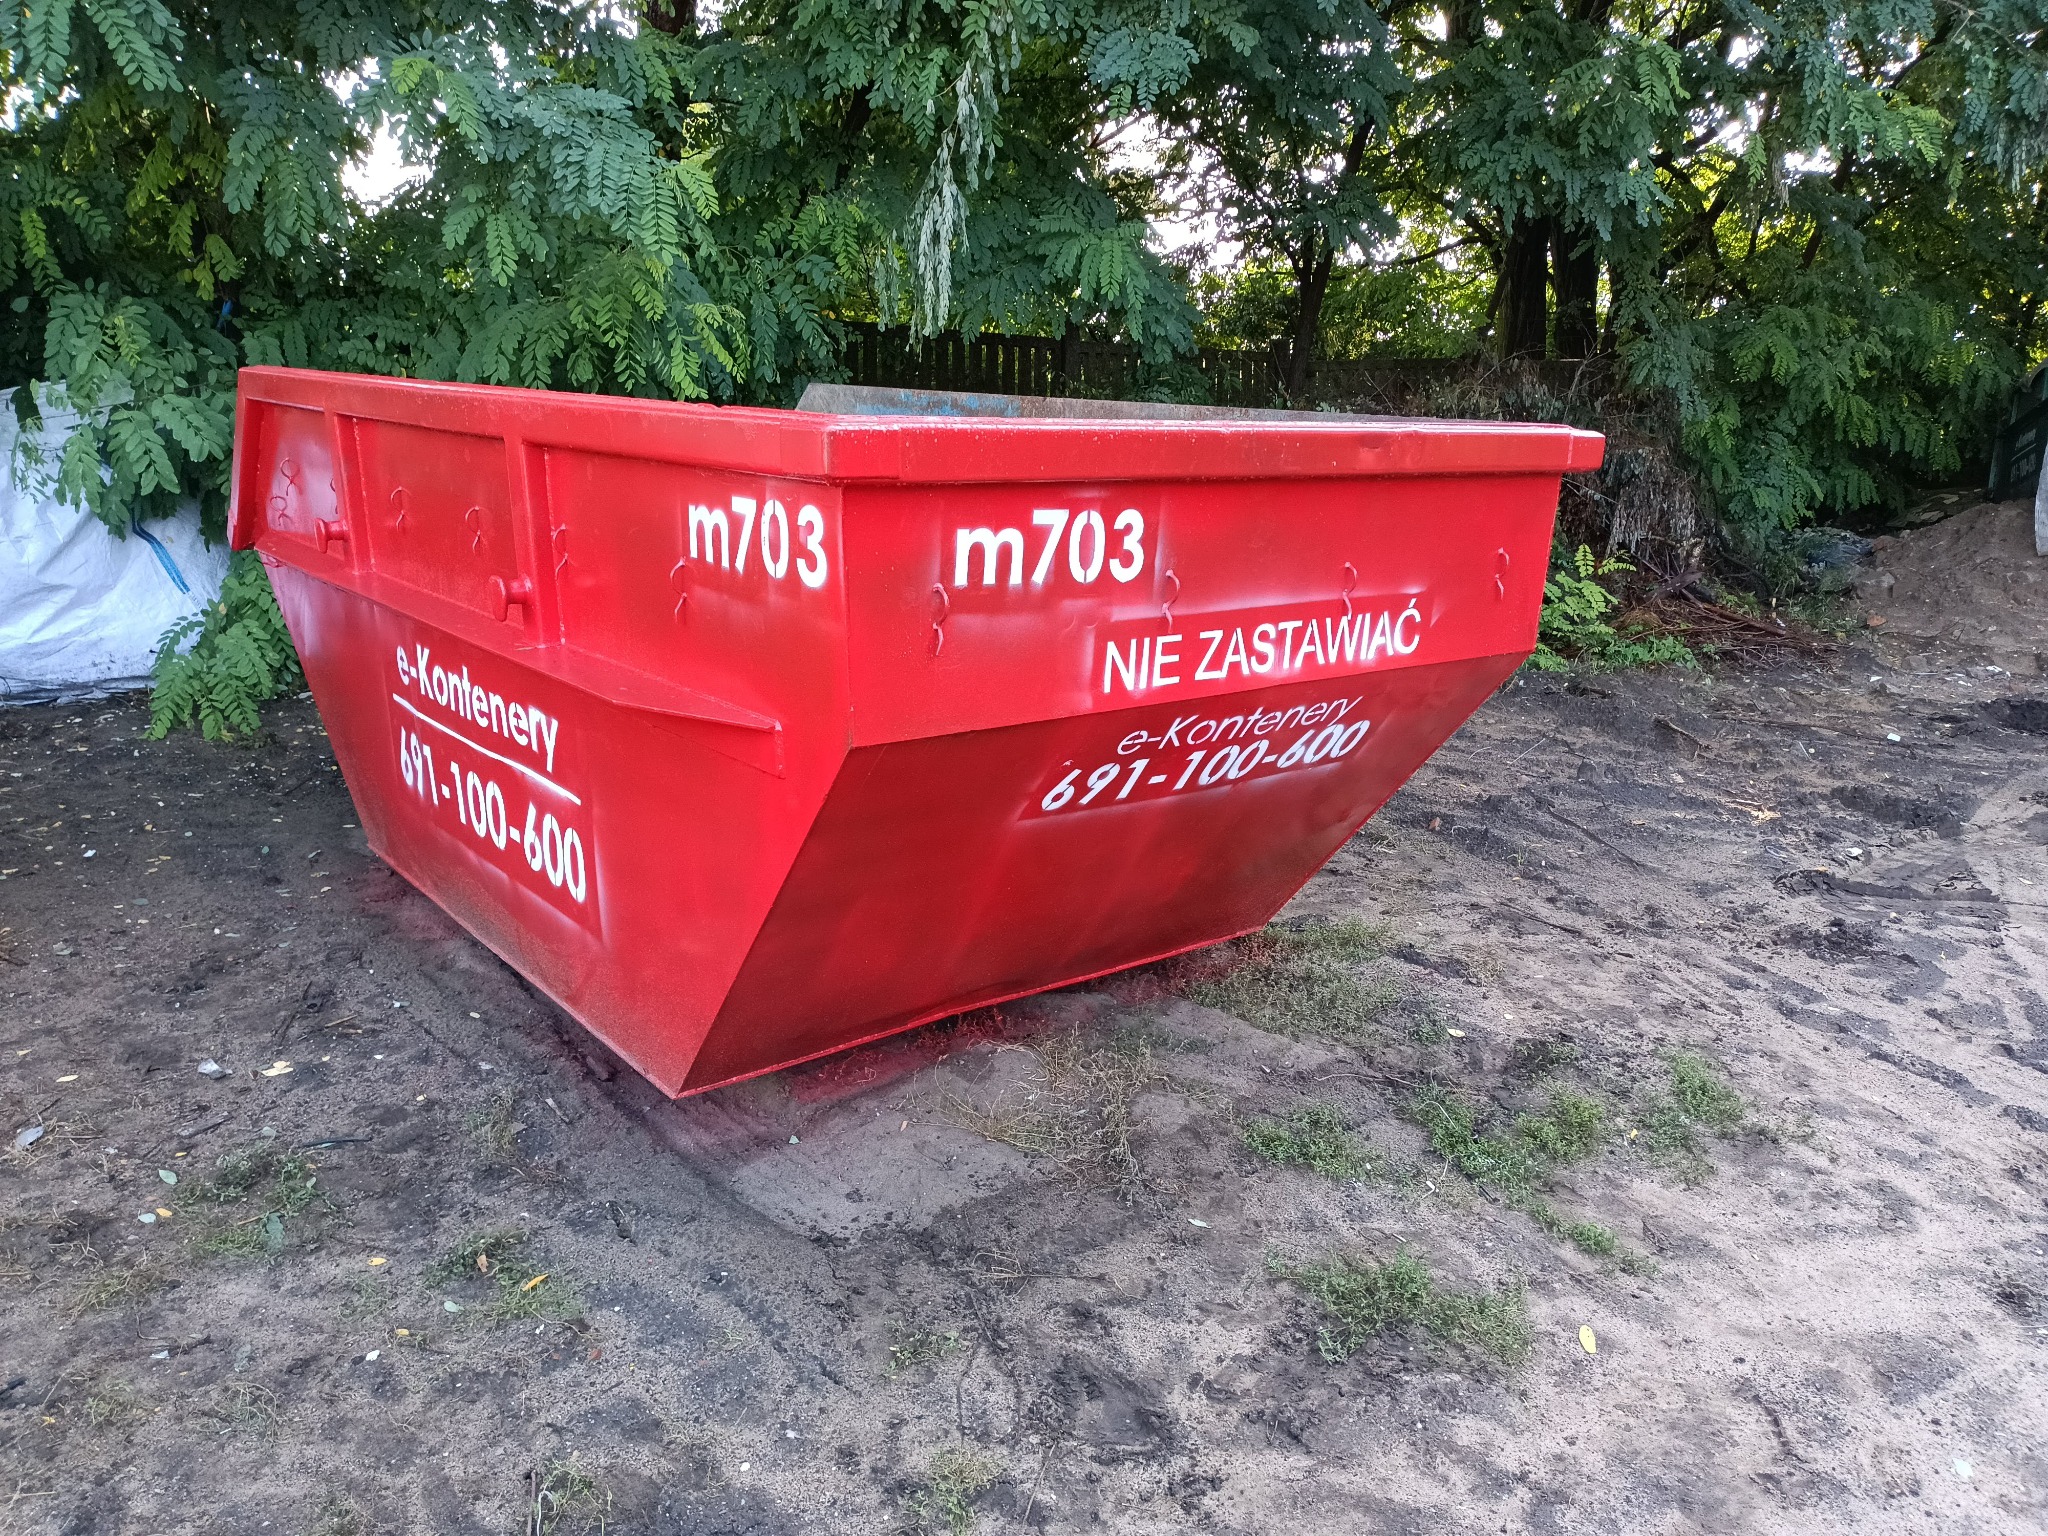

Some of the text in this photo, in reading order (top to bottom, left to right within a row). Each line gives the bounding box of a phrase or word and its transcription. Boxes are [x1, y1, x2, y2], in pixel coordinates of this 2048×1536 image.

[688, 493, 830, 590] m703
[953, 508, 1145, 588] m703
[1103, 597, 1422, 694] NIE ZASTAWIAĆ
[396, 643, 559, 774] e-Kontenery
[1117, 694, 1363, 756] e-Kontenery
[1041, 719, 1371, 811] 691-100-600
[400, 725, 588, 904] 691-100-600
